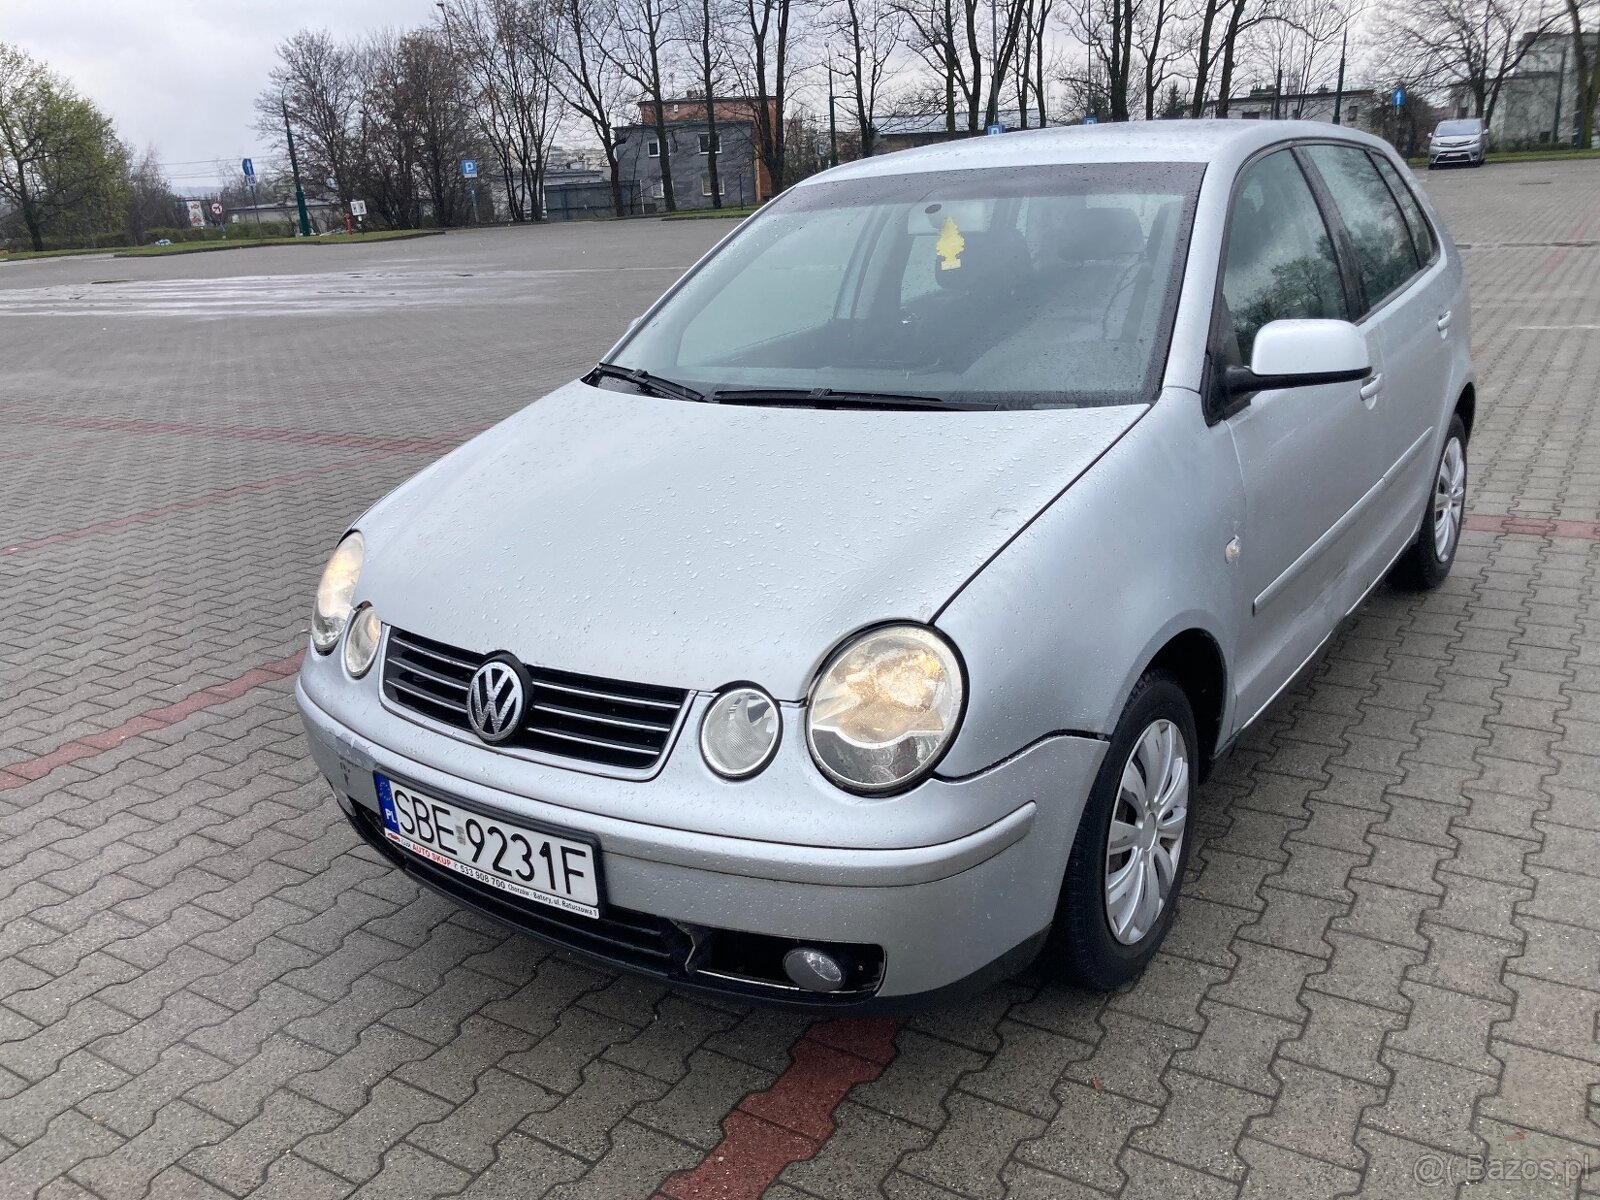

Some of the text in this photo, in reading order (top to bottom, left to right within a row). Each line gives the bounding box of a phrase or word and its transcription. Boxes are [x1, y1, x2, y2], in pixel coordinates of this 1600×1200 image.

[385, 807, 397, 824] PL
[394, 789, 586, 895] SBE 9231F
[412, 844, 430, 858] AUTO
[432, 853, 451, 867] SKUP
[460, 865, 473, 877] 533
[491, 877, 506, 889] 700
